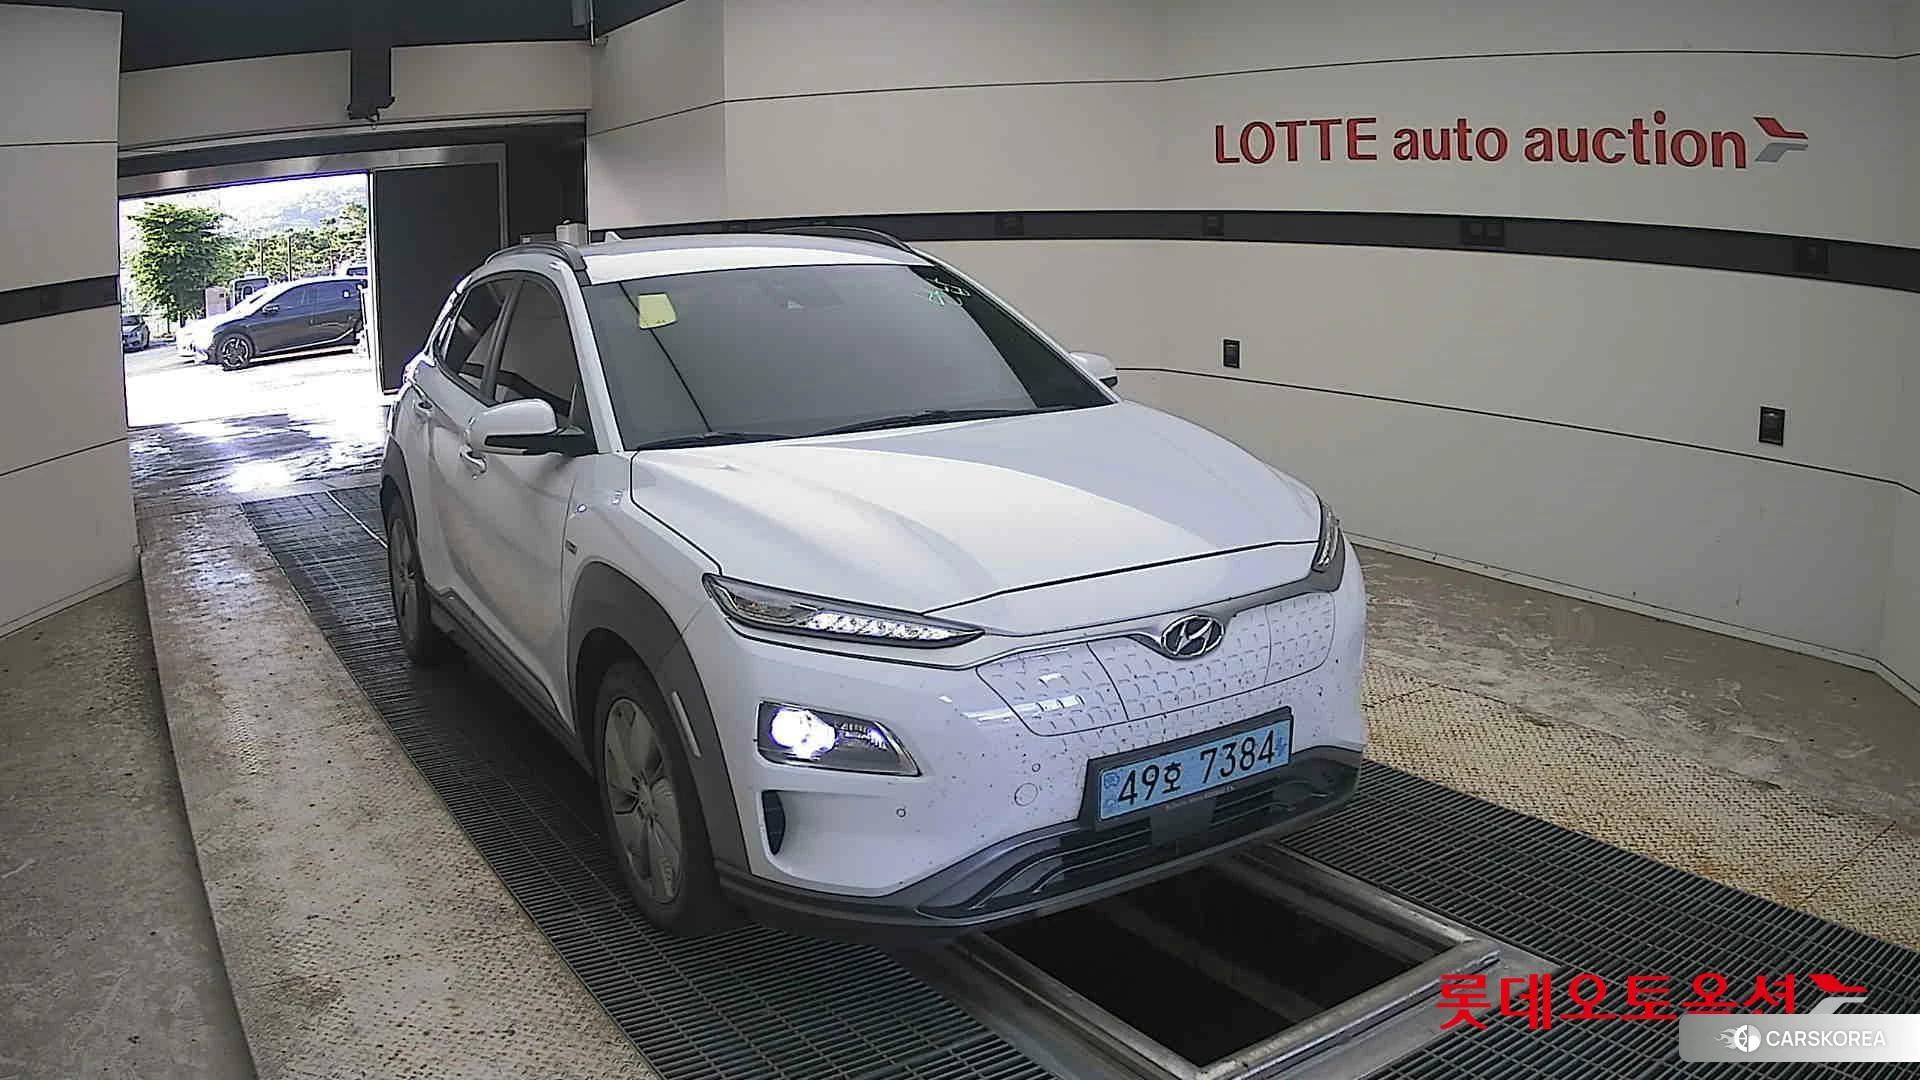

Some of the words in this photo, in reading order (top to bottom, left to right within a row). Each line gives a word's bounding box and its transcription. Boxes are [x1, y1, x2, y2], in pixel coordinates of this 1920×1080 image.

[1214, 117, 1378, 164] LOTTE
[1392, 117, 1509, 163] auto
[1523, 110, 1748, 169] auction
[1117, 761, 1182, 806] 49호
[1199, 729, 1276, 785] 7384
